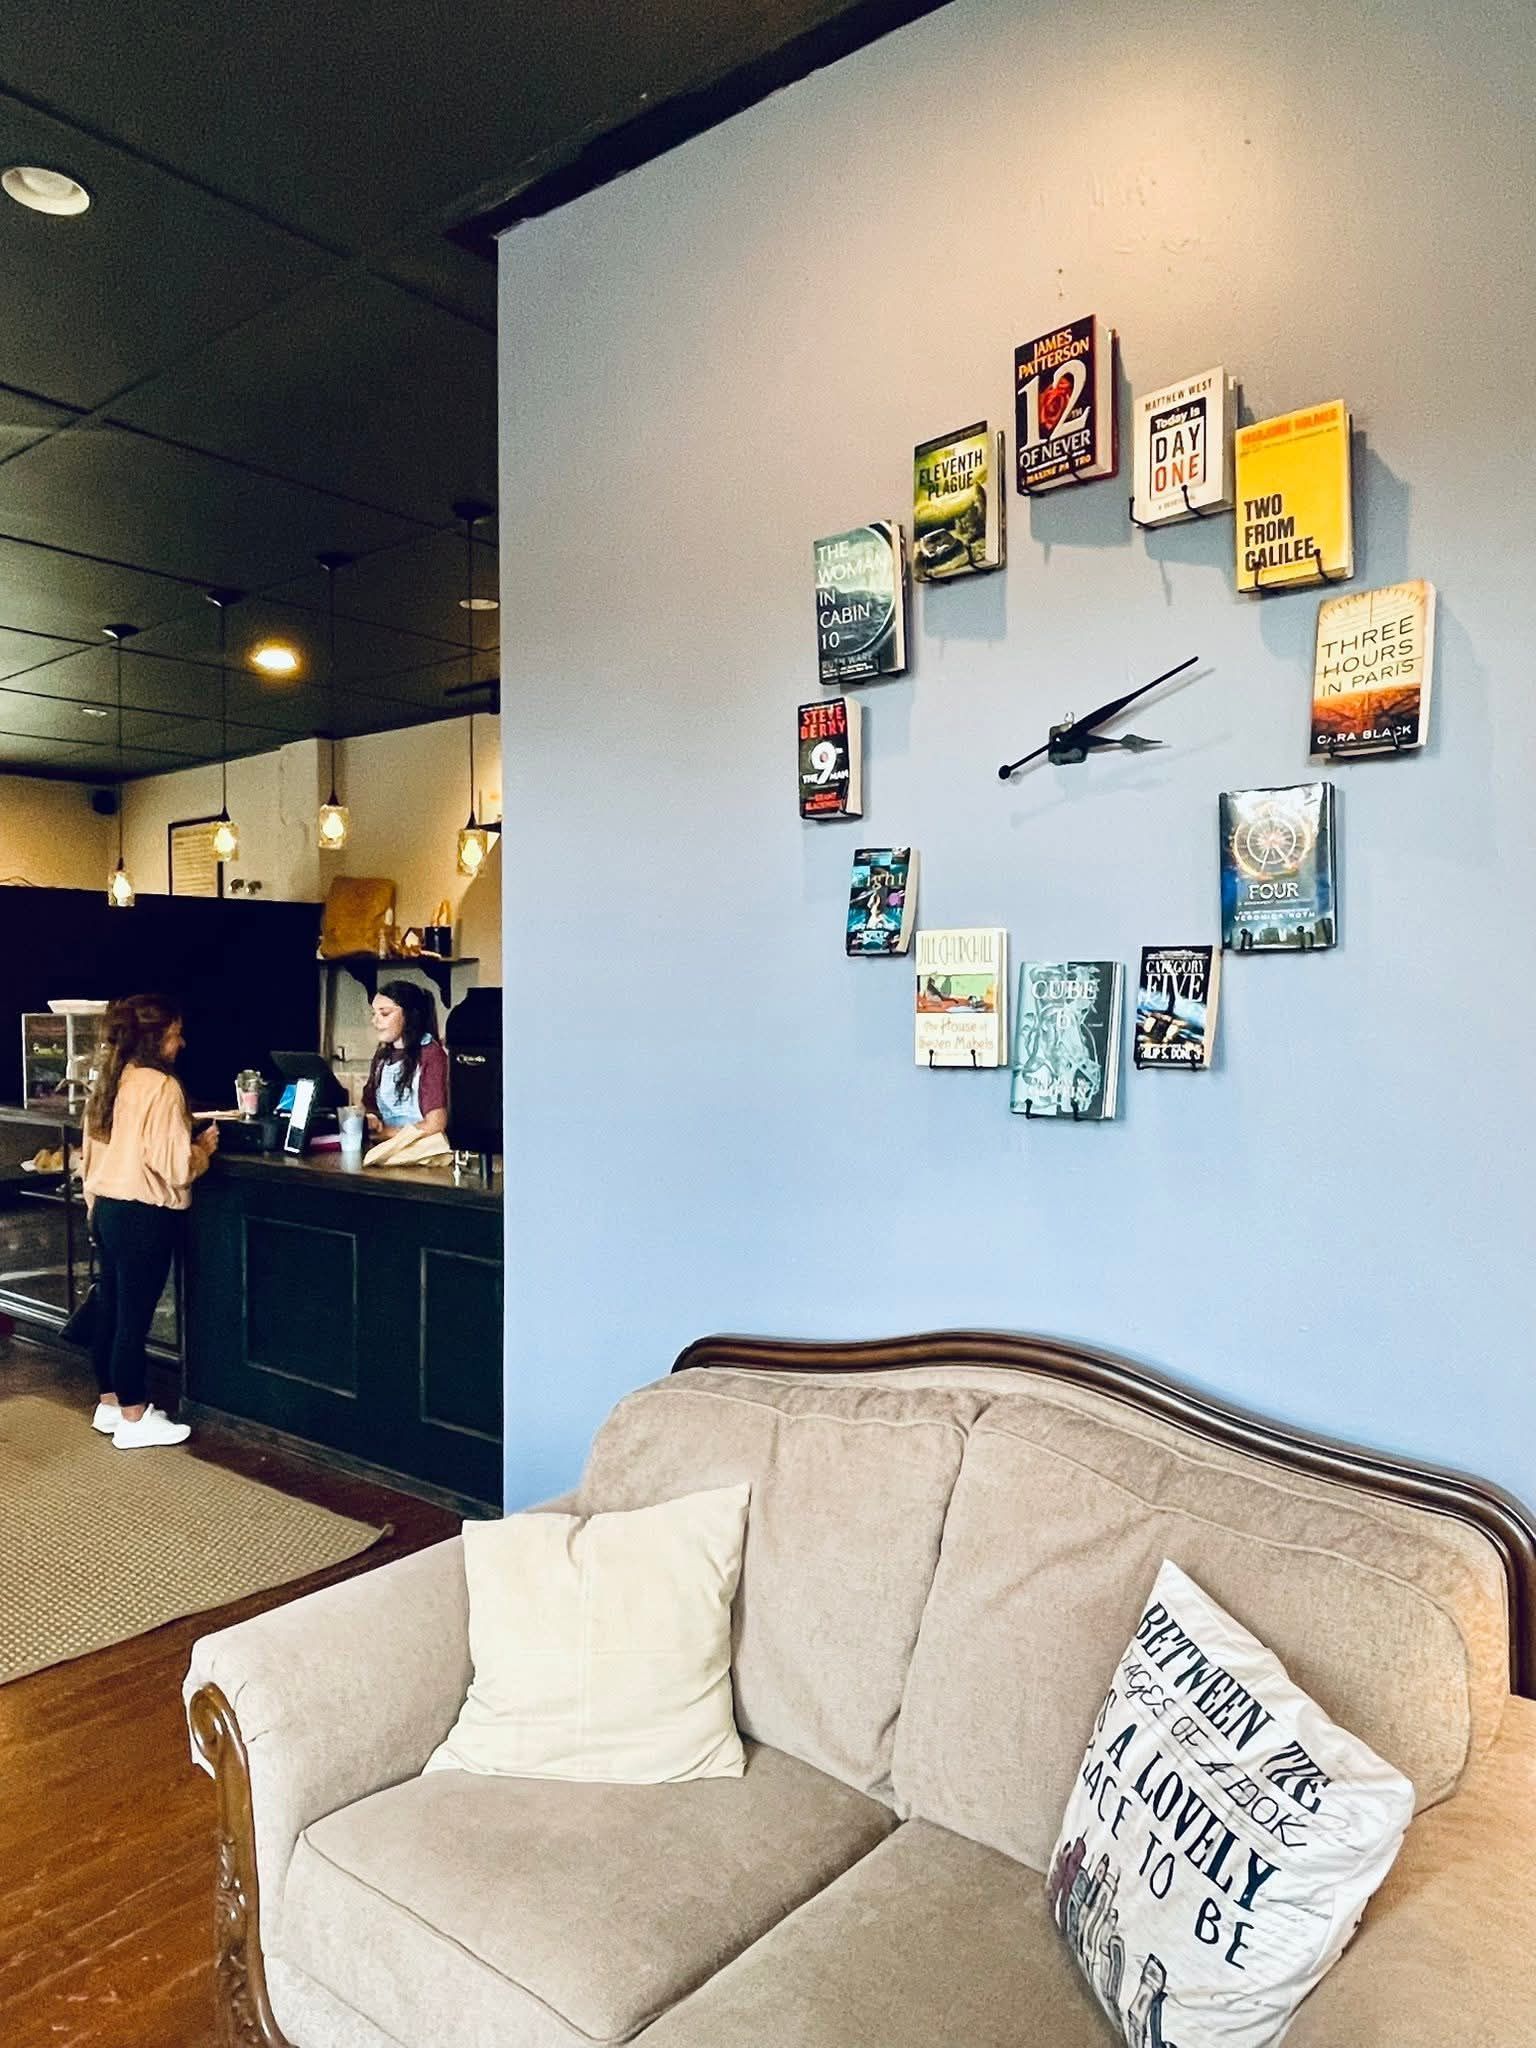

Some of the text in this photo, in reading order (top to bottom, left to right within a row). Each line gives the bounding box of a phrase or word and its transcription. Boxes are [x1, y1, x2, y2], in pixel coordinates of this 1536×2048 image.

[1018, 336, 1090, 379] PATTERSON
[1034, 328, 1073, 359] JAMES
[1144, 378, 1213, 412] MATTHEW WEST
[1155, 411, 1188, 430] Today
[1019, 429, 1091, 469] OF NEVER
[1155, 423, 1201, 464] DAY
[919, 449, 983, 487] ELEVENTH
[1059, 455, 1092, 473] PATRO
[1155, 453, 1200, 493] ONE
[927, 470, 974, 501] PLAGUE
[1243, 493, 1283, 522] TWO
[1244, 516, 1295, 548] FROM
[817, 540, 849, 563] THE
[1245, 536, 1315, 573] GALILEE
[819, 589, 836, 607] IN
[819, 602, 870, 629] CABIN
[821, 631, 840, 650] 10
[1321, 615, 1414, 659] THREE
[1323, 639, 1414, 678] HOURS
[1322, 659, 1414, 697] IN PARIS
[803, 705, 844, 725] STEVE
[1248, 882, 1300, 900] FOUR
[1146, 973, 1204, 1004] FIVE
[1136, 1601, 1276, 1751] BETWEEN
[1121, 1655, 1176, 1720] AGES
[1171, 1716, 1209, 1747] OF
[1106, 1723, 1138, 1772] A
[1131, 1751, 1281, 1912] LOVELY
[1082, 1745, 1255, 1971] LACE TO BE
